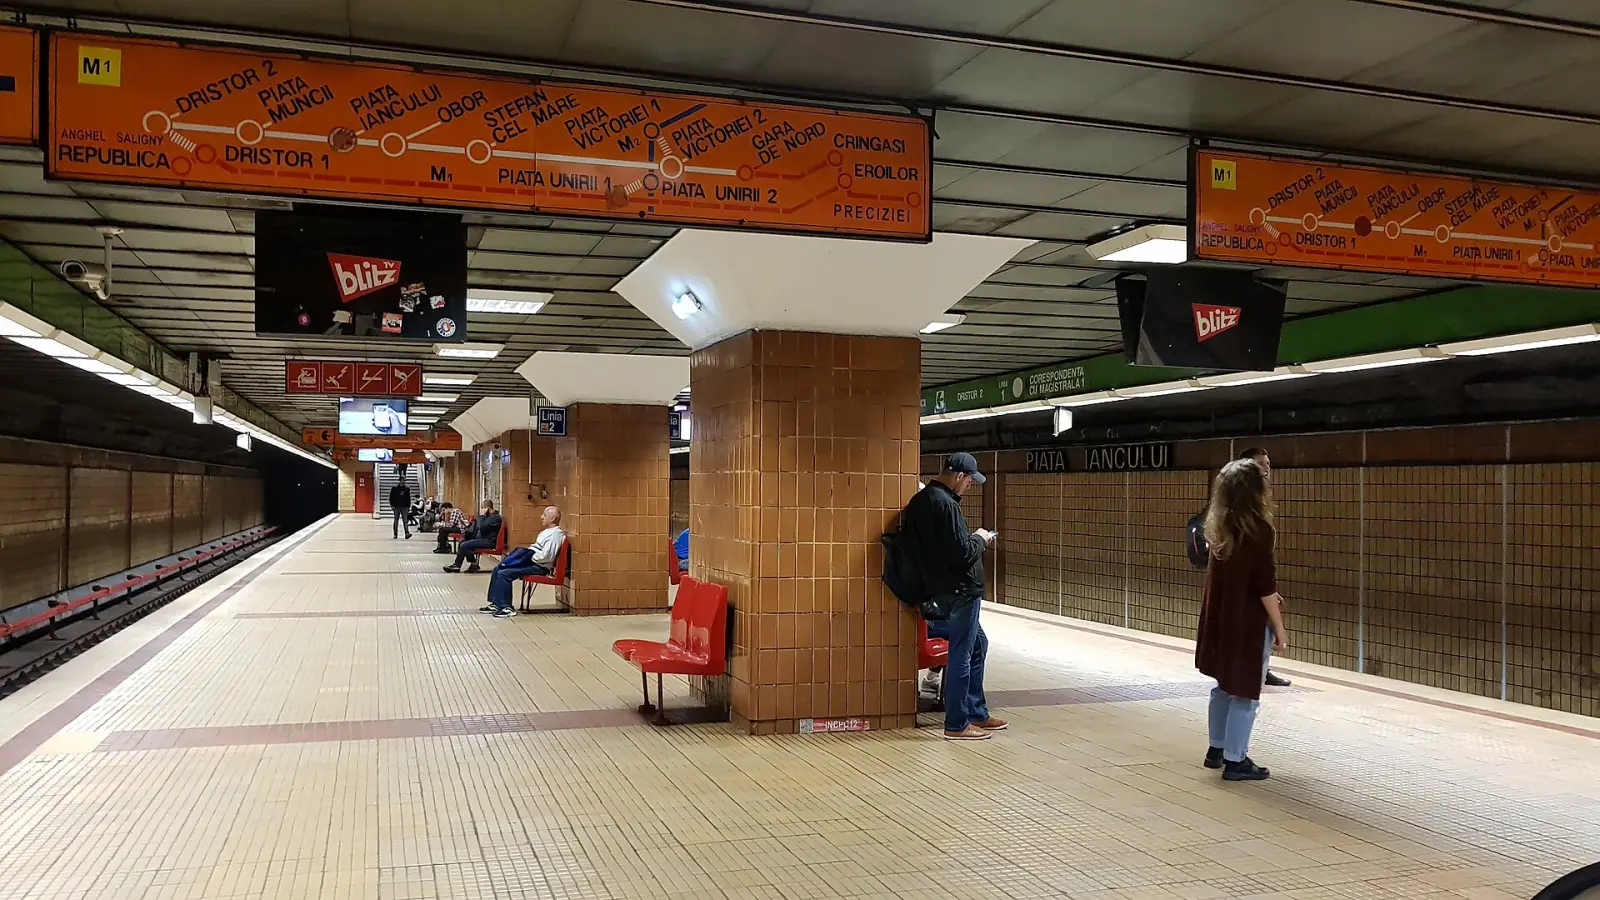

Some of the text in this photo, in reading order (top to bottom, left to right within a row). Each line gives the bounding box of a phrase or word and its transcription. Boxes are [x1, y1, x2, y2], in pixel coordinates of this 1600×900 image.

[175, 59, 278, 114] DRISTOR 2
[257, 75, 310, 107] PIATA
[350, 84, 400, 114] PIATA
[267, 84, 334, 124] MUNCII
[359, 84, 442, 131] IANCULUI
[436, 90, 488, 124] OBOR
[482, 88, 550, 127] STEFAN
[491, 92, 581, 144] CEL MARE
[564, 105, 609, 135] PIATA
[573, 98, 662, 150] VICTORIEI 1
[60, 128, 163, 146] ANGHEL SALIGNY
[671, 117, 715, 146] PIATA
[680, 108, 768, 159] VICTORIEI 2
[751, 120, 796, 150] GARA
[758, 121, 826, 165] DE NORD
[833, 132, 906, 154] CRINGASI
[58, 144, 170, 170] REPUBLICA
[224, 144, 329, 169] DRISTOR 1
[498, 168, 611, 192] PIATA UNIRII 1
[854, 163, 918, 181] EROILOR
[661, 181, 777, 204] PIATA UNIRII 2
[1267, 167, 1326, 209] DRISTOR 2
[1313, 179, 1344, 202] PIATA
[1320, 186, 1358, 216] MUNCII
[1367, 184, 1396, 208] PIATA
[1417, 187, 1448, 213] OBOR
[1444, 183, 1482, 216] STEFAN
[834, 203, 910, 222] PRECIZIEI
[1373, 183, 1421, 220] IANCULUI
[1450, 184, 1501, 228] CEL MARE
[1491, 196, 1518, 219] PIATA
[1496, 194, 1541, 231] VICTORIEI
[1234, 223, 1262, 234] SALIGNY
[1554, 205, 1580, 227] PIATA
[1201, 234, 1264, 251] REPUBLICA
[1296, 232, 1356, 249] DRISTOR 1
[1453, 246, 1521, 261] PIATA UNIRII 1
[383, 261, 395, 269] TV
[1549, 254, 1576, 267] PIATA
[334, 261, 397, 296] blitz
[1196, 309, 1238, 337] blitz
[1029, 366, 1085, 385] CORESPONDENTA
[1029, 378, 1085, 396] CU MAGISTRALA 1
[957, 389, 983, 402] DRISTOR 2
[1001, 389, 1005, 401] 1
[541, 409, 563, 421] Linia
[548, 422, 555, 432] 2
[1026, 445, 1168, 471] PIATA IANCULUI
